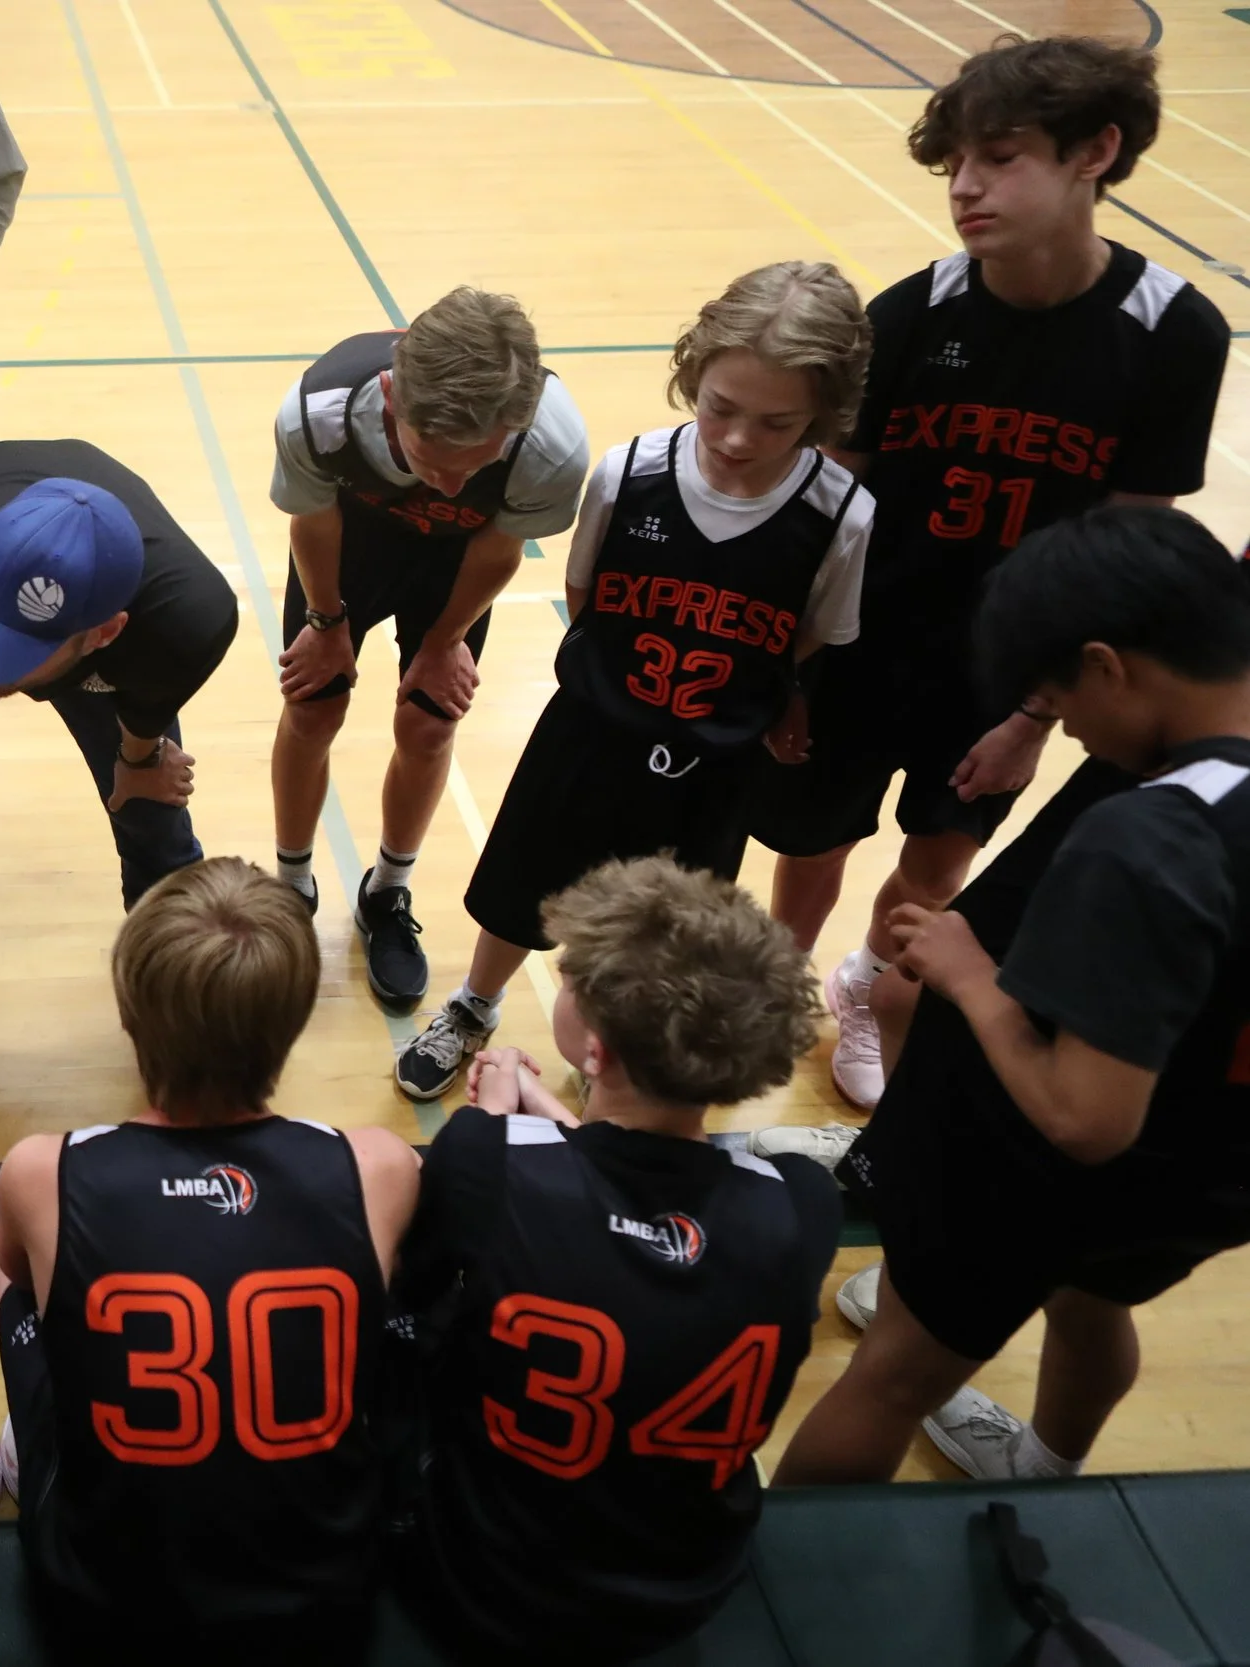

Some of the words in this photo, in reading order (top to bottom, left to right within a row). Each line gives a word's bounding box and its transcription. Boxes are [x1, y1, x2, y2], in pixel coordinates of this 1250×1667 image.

[880, 403, 1119, 480] EXPRESS
[628, 527, 669, 542] XEIST
[928, 466, 1035, 548] 31
[596, 572, 797, 655] EXPRESS
[626, 632, 734, 719] 32
[161, 1178, 225, 1196] LMBA
[609, 1213, 670, 1242] LMBA
[85, 1266, 359, 1466] 30
[482, 1293, 781, 1490] 34
